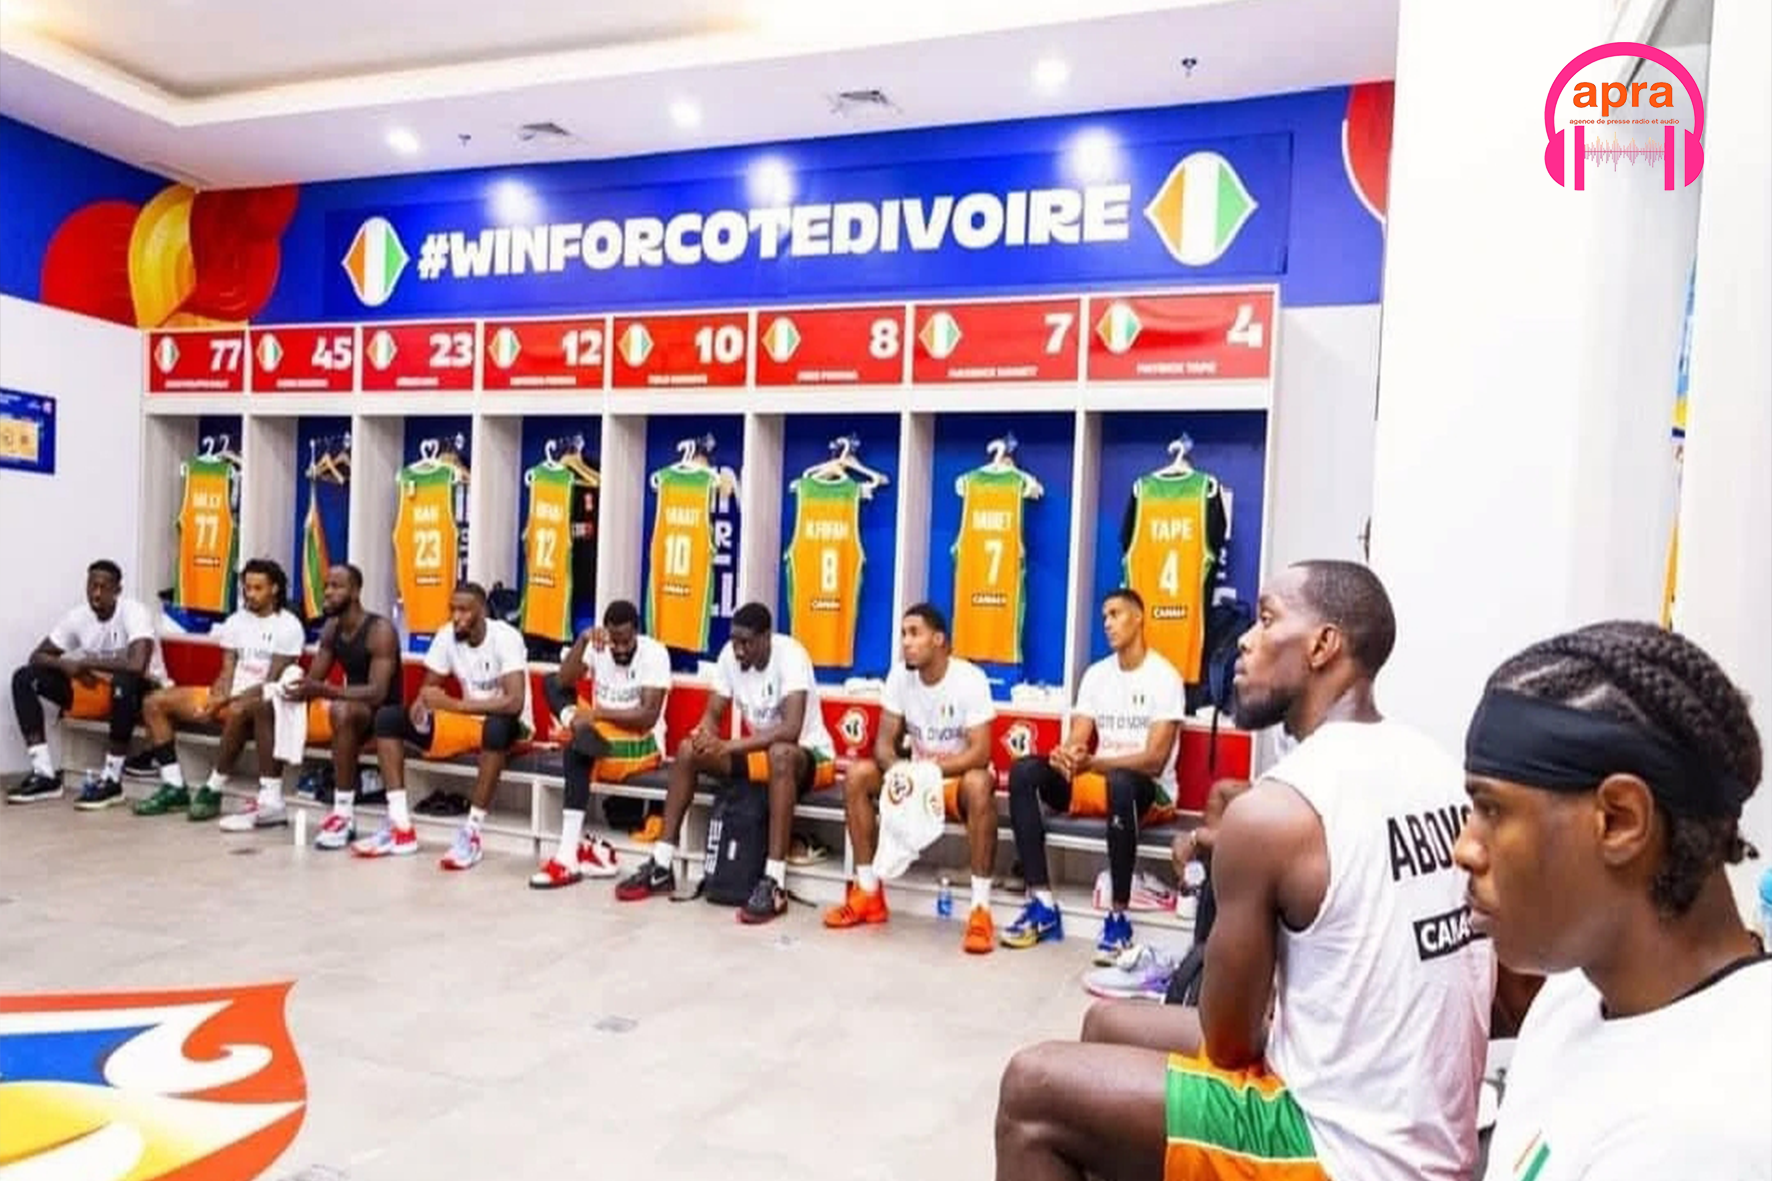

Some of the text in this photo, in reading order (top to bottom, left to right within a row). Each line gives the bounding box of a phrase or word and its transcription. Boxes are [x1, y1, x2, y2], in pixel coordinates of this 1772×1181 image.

[418, 185, 1130, 280] #WINFORCOTEDIVOIRE
[695, 325, 744, 364] 10
[869, 318, 899, 359] 8
[1043, 312, 1074, 355] 7
[1225, 304, 1263, 348] 4
[209, 338, 243, 371] 77
[310, 335, 353, 370] 45
[429, 332, 473, 368] 23
[561, 329, 603, 367] 12
[194, 514, 219, 550] 77
[413, 529, 442, 569] 23
[535, 528, 558, 569] 12
[1151, 517, 1193, 541] TAPE
[664, 532, 692, 577] 10
[821, 548, 838, 593] 8
[984, 540, 1004, 586] 7
[1157, 549, 1180, 599] 4
